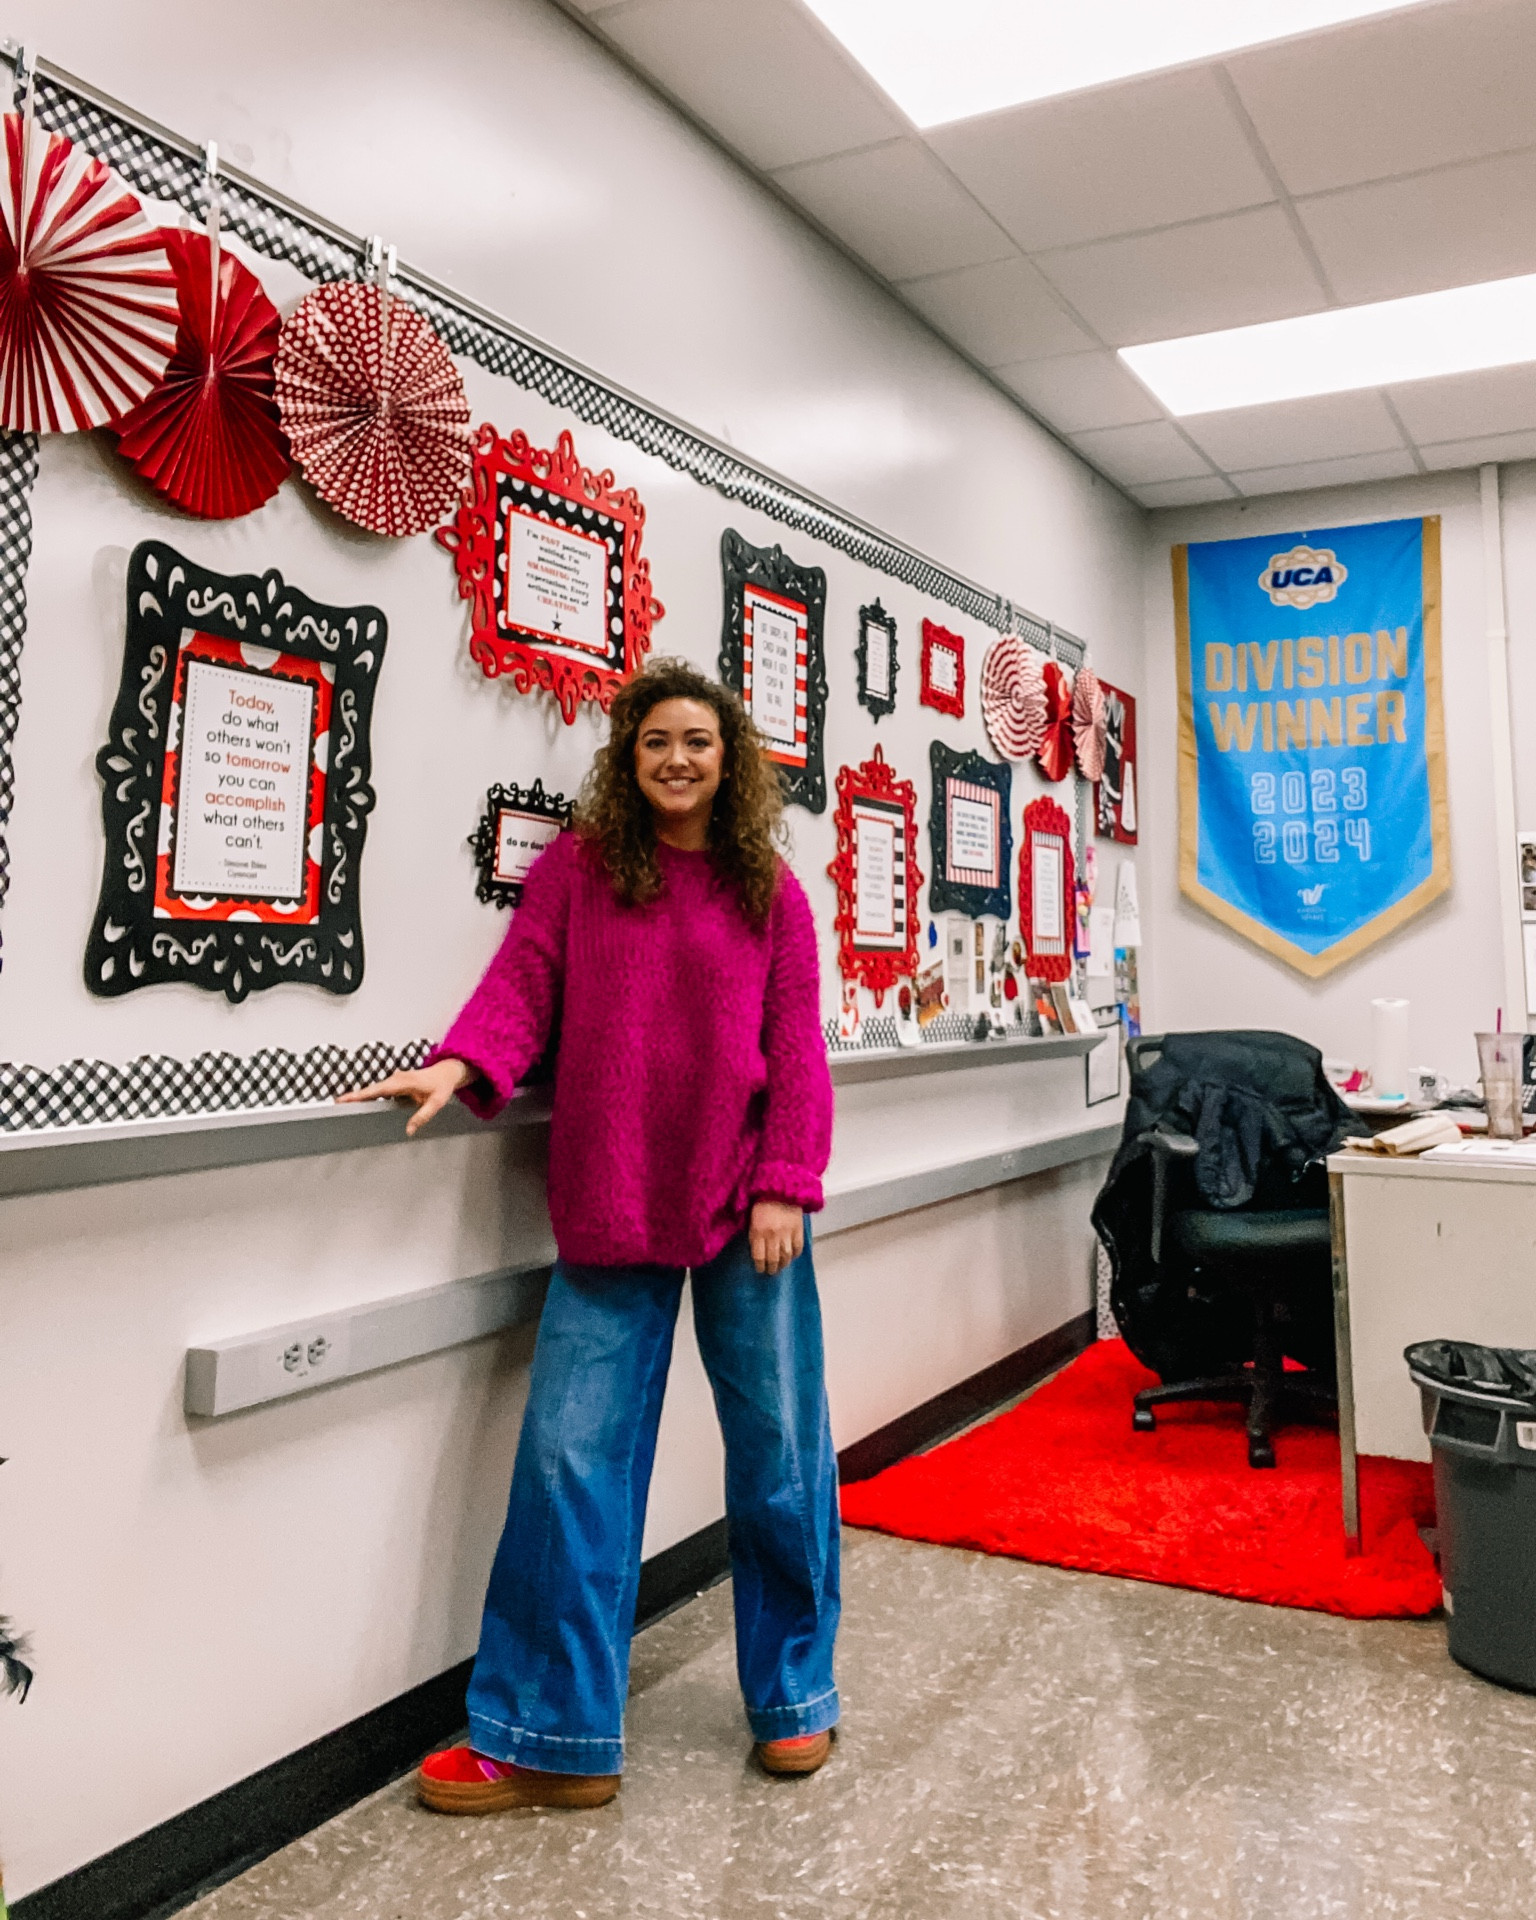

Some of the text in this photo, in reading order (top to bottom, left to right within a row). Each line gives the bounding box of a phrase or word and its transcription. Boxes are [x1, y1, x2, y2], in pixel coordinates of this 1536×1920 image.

[1271, 565, 1334, 588] UCA
[1204, 626, 1408, 693] DIVISION
[229, 689, 275, 714] Today,
[222, 710, 279, 733] do what
[1208, 690, 1408, 753] WINNER
[206, 729, 290, 754] others won't
[205, 751, 291, 773] so tomorrow
[218, 774, 276, 791] you can
[1250, 766, 1369, 815] 2023
[205, 792, 286, 812] accomplish
[204, 809, 285, 832] what others
[225, 834, 263, 850] can't.
[506, 836, 517, 847] do
[520, 840, 529, 848] or
[1252, 816, 1371, 864] 2024
